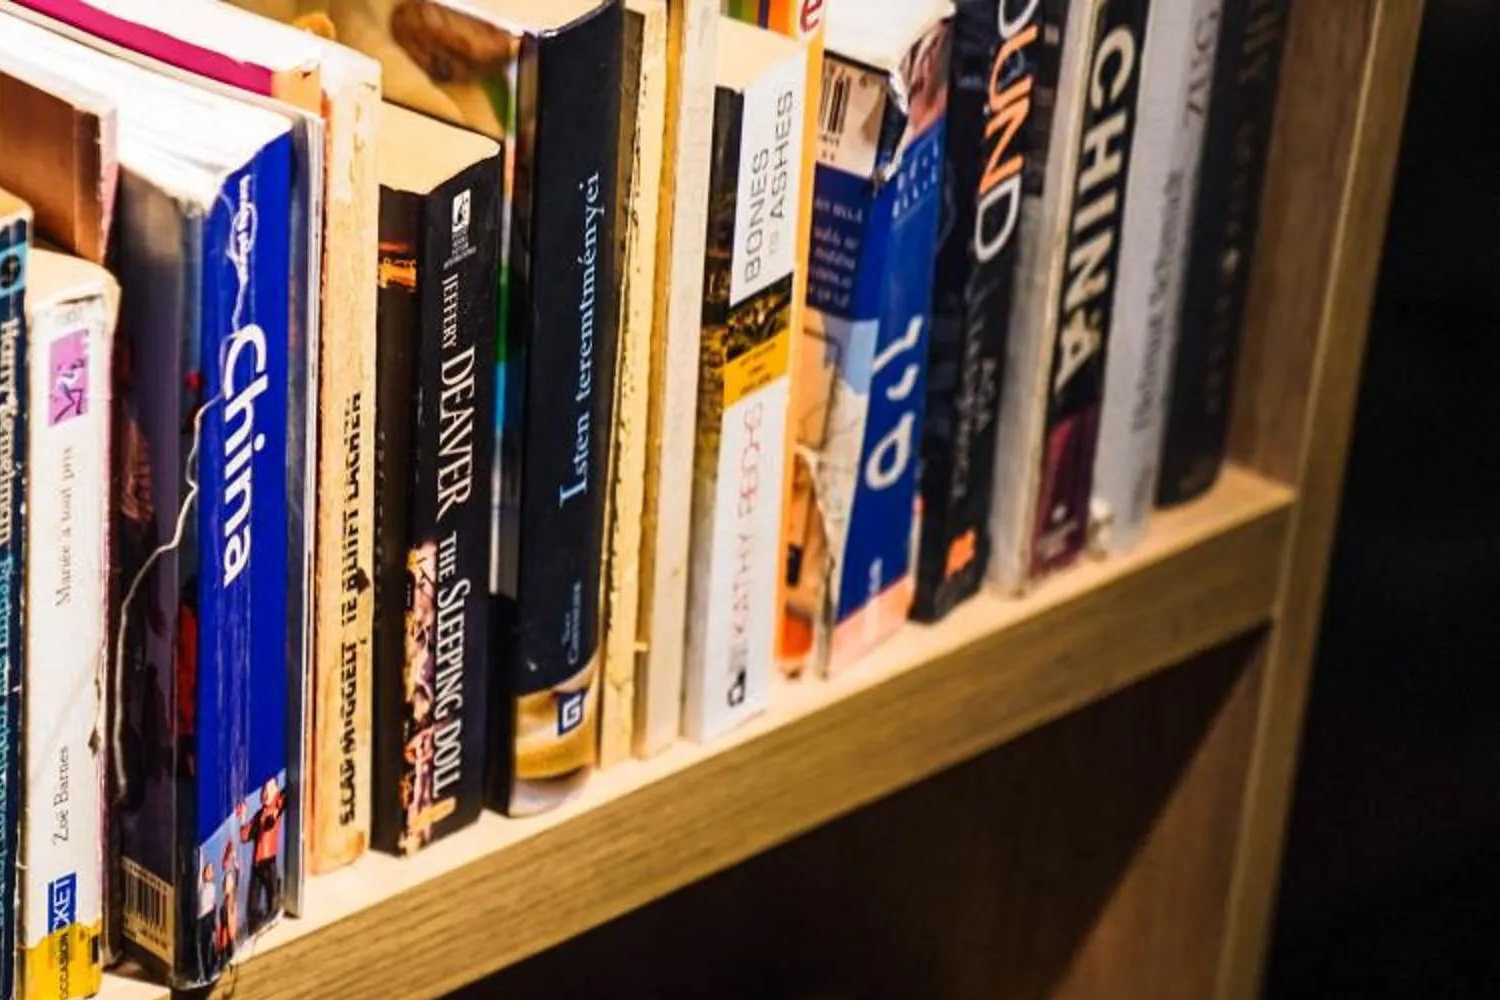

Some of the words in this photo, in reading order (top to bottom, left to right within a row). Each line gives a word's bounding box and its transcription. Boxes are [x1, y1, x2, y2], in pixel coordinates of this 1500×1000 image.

[744, 148, 770, 284] BONES
[770, 90, 794, 219] ASHES
[1053, 27, 1136, 393] CHINA
[575, 171, 606, 402] teremtményei
[223, 323, 269, 587] China
[437, 345, 476, 521] DEAVER
[560, 411, 591, 508] Isten
[437, 531, 458, 584] THE
[435, 578, 471, 720] SLEEPING
[432, 714, 465, 797] DOLL
